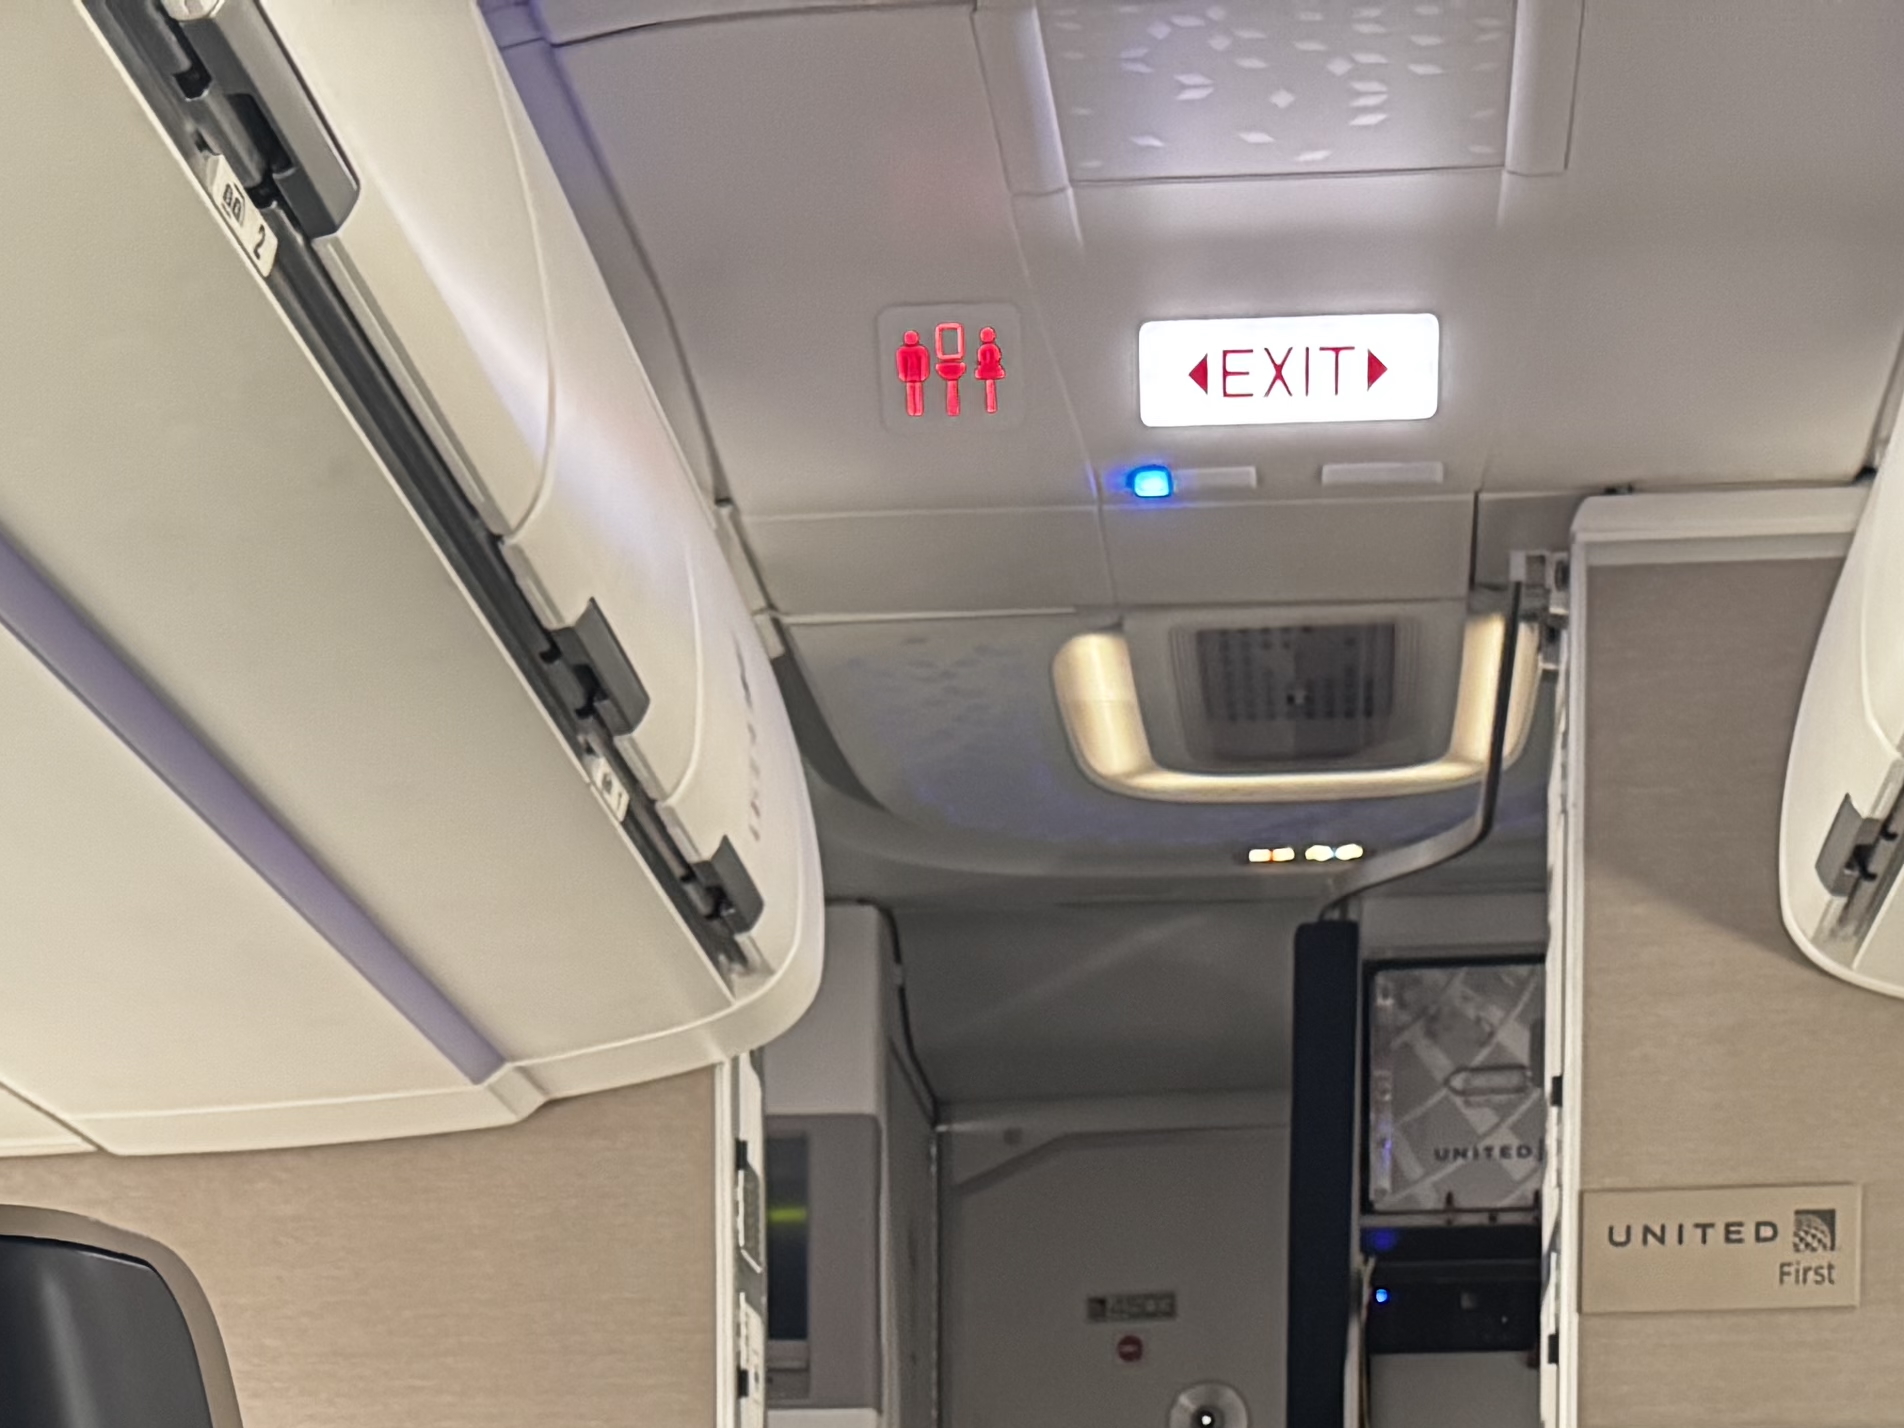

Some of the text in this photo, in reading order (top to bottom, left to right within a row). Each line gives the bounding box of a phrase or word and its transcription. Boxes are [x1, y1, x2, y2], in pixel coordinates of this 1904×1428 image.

[253, 223, 266, 260] 2
[1222, 346, 1355, 398] EXIT
[1434, 1144, 1533, 1162] UNITED
[1607, 1220, 1779, 1249] UNITED
[1778, 1261, 1836, 1287] First
